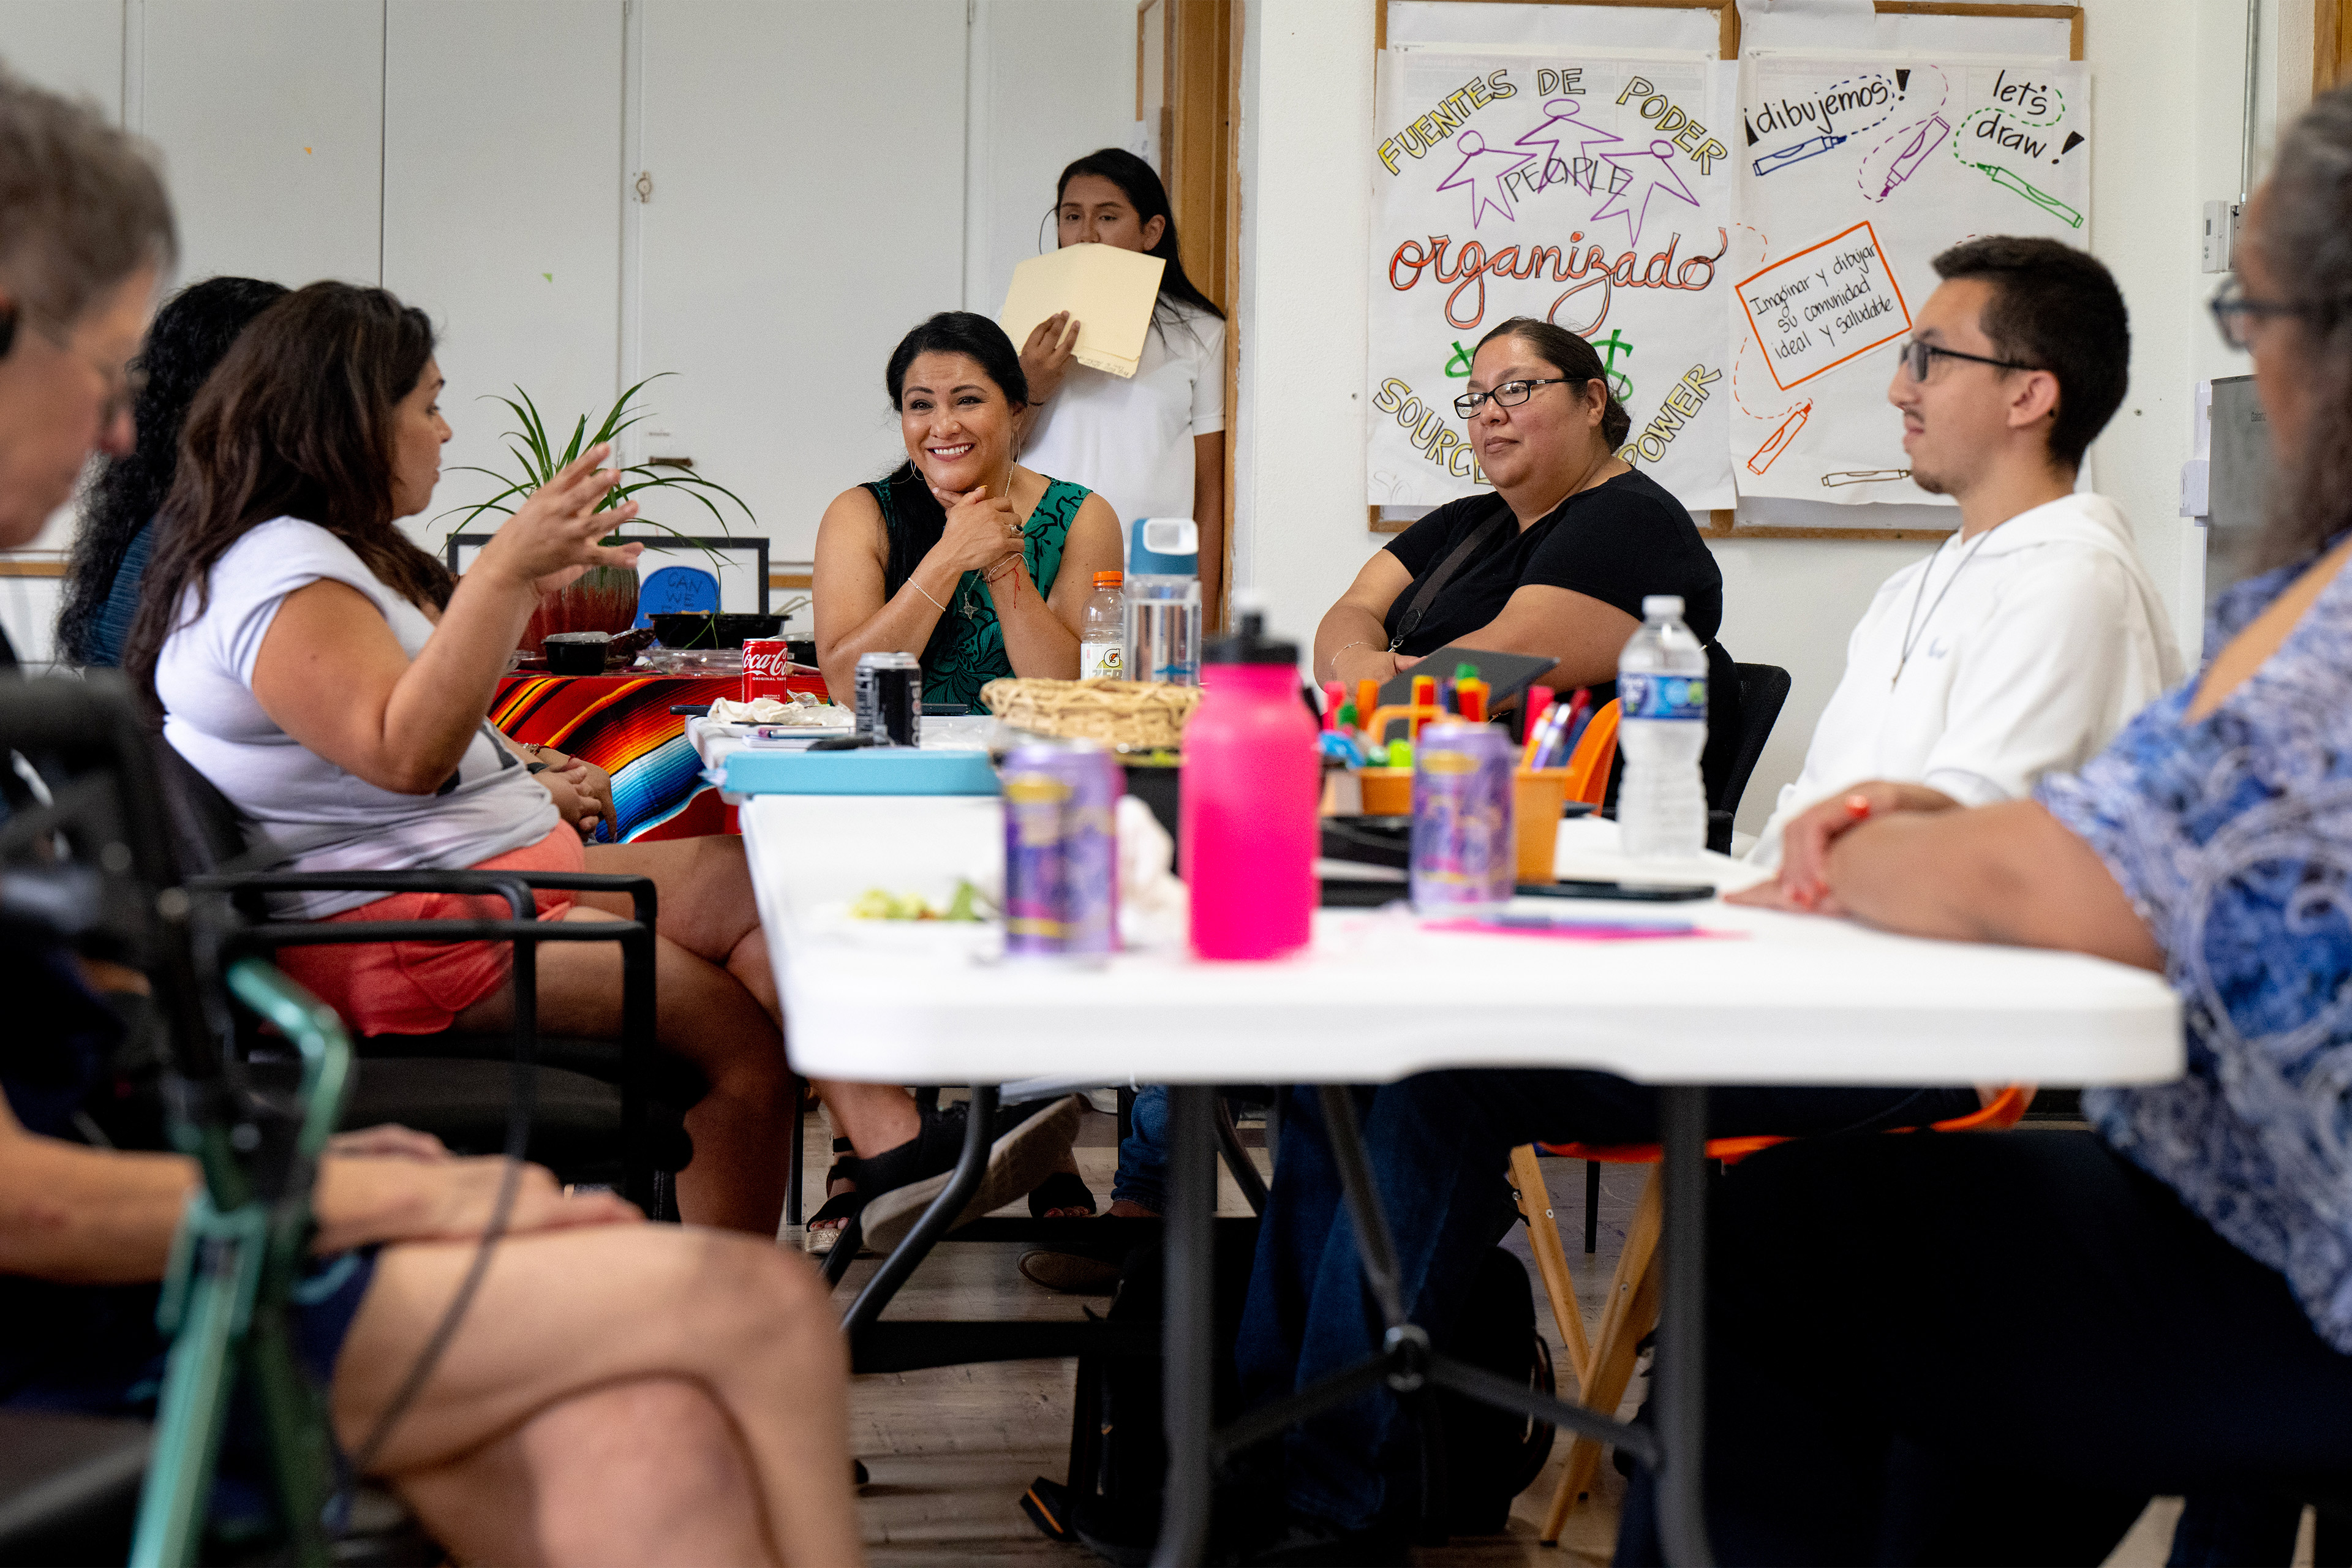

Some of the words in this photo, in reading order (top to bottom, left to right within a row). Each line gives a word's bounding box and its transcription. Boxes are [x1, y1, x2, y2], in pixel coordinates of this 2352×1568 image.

[1992, 69, 2048, 116] let's
[1377, 69, 1518, 176] FUENTES
[1537, 68, 1586, 96] DE
[1616, 76, 1728, 176] PODER
[1503, 156, 1634, 203] PEOPLE
[1389, 227, 1728, 338] organizado
[1749, 276, 1811, 318] Imaginar
[1833, 243, 1876, 274] dibujar
[1803, 273, 1872, 322] comunidad
[1771, 331, 1812, 360] ideal
[665, 590, 695, 607] WE
[667, 571, 704, 594] CAN
